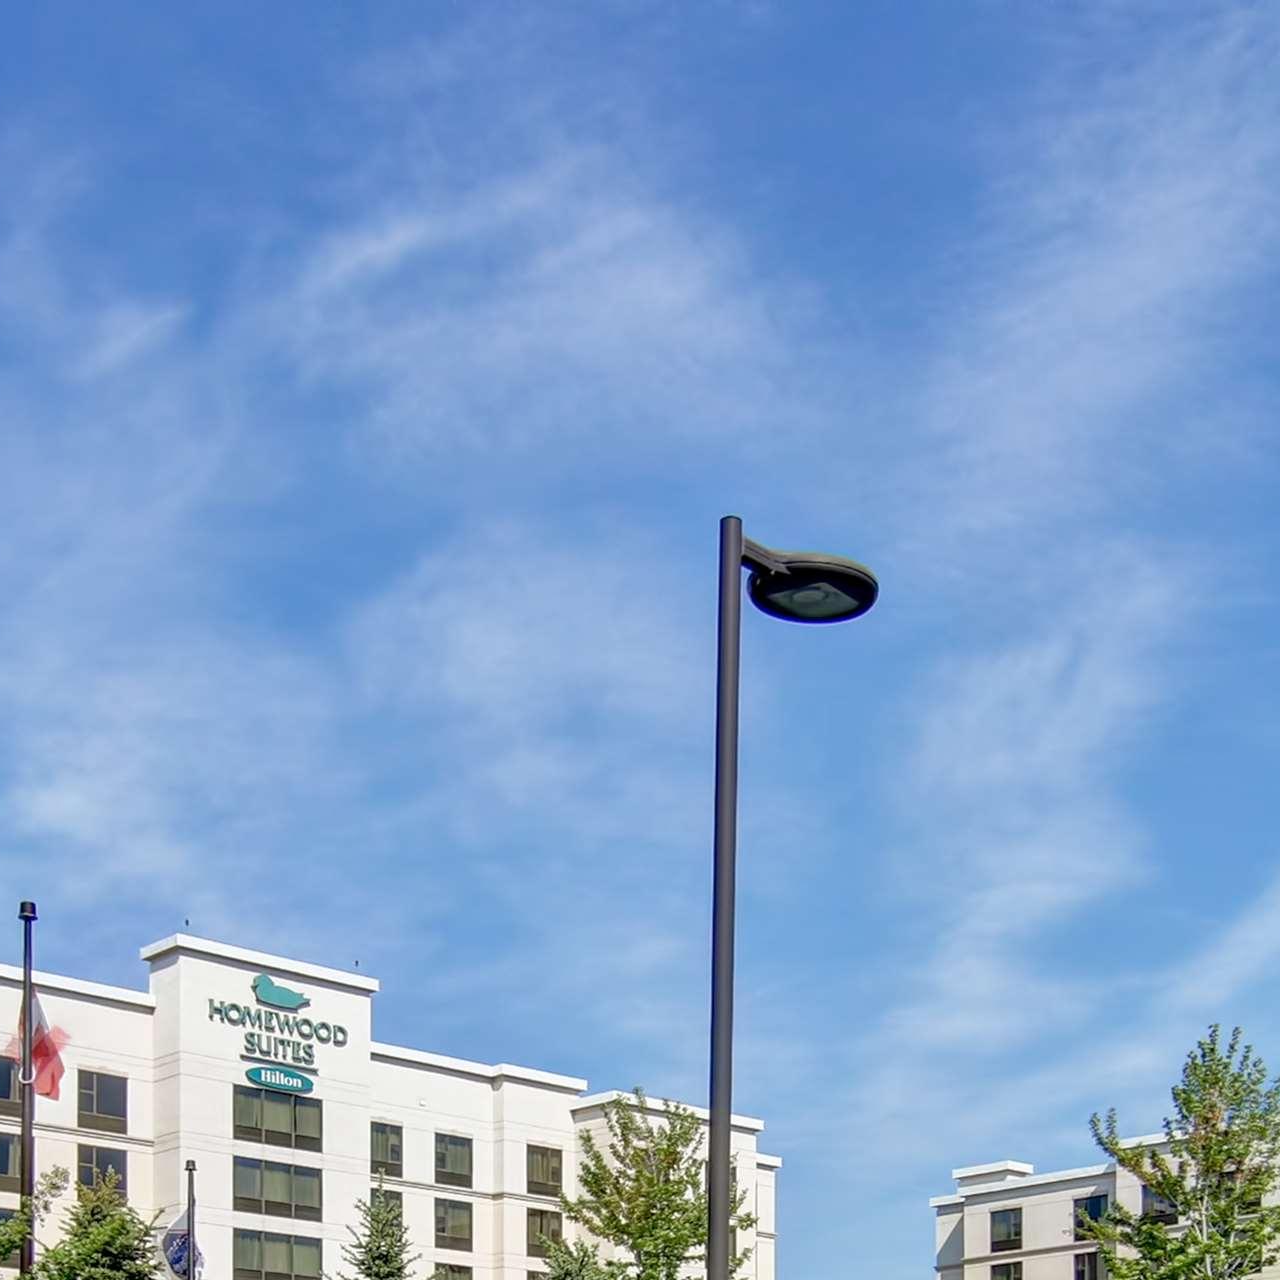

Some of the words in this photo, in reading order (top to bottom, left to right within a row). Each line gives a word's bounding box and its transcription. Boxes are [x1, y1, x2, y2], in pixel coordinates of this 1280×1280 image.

[208, 998, 349, 1048] HOMEWOOD
[244, 1031, 315, 1065] SUITES
[260, 1069, 303, 1088] Hilton
